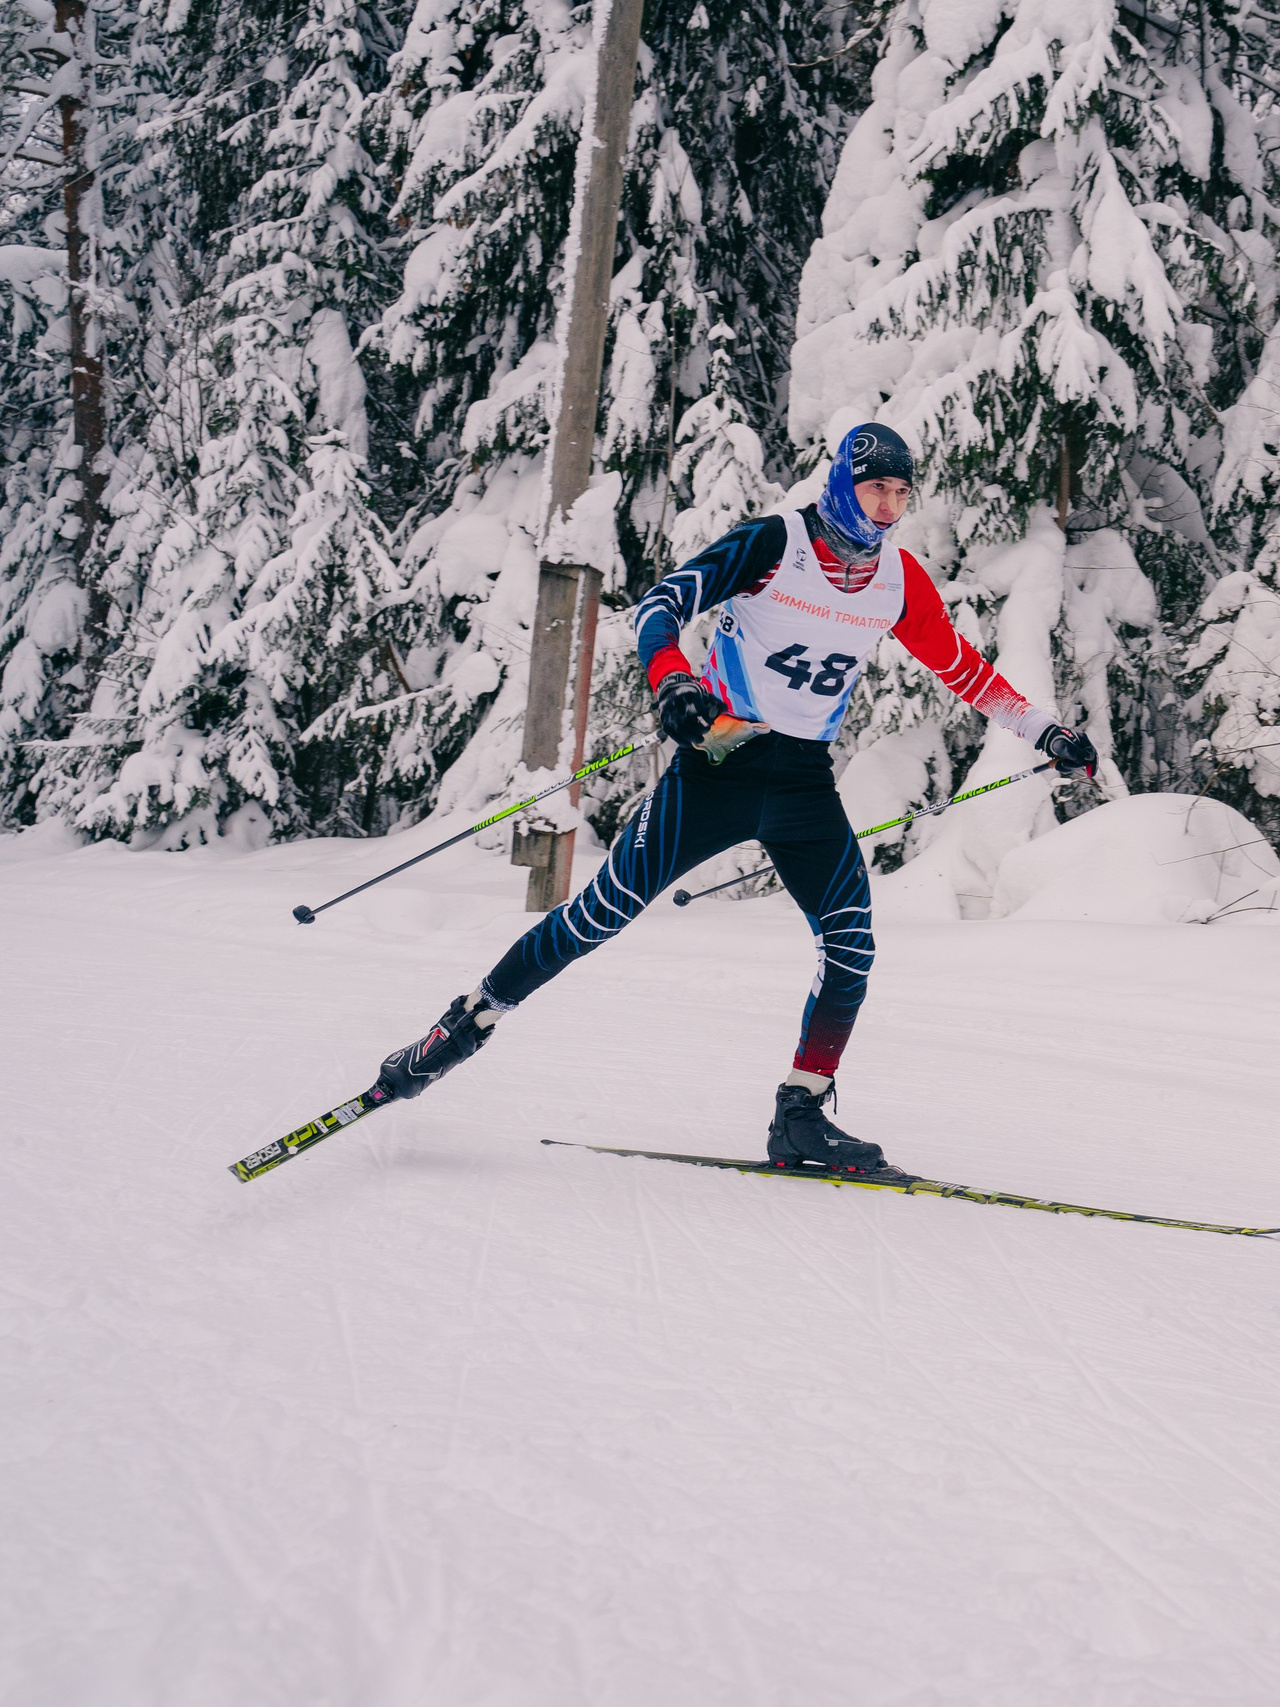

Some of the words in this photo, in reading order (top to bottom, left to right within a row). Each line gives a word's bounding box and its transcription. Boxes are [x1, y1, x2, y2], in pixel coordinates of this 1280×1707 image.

[769, 589, 831, 620] ЗИМНИЙ
[764, 643, 858, 697] 48
[634, 787, 656, 848] ORDSKI
[244, 1141, 282, 1170] FISCHER
